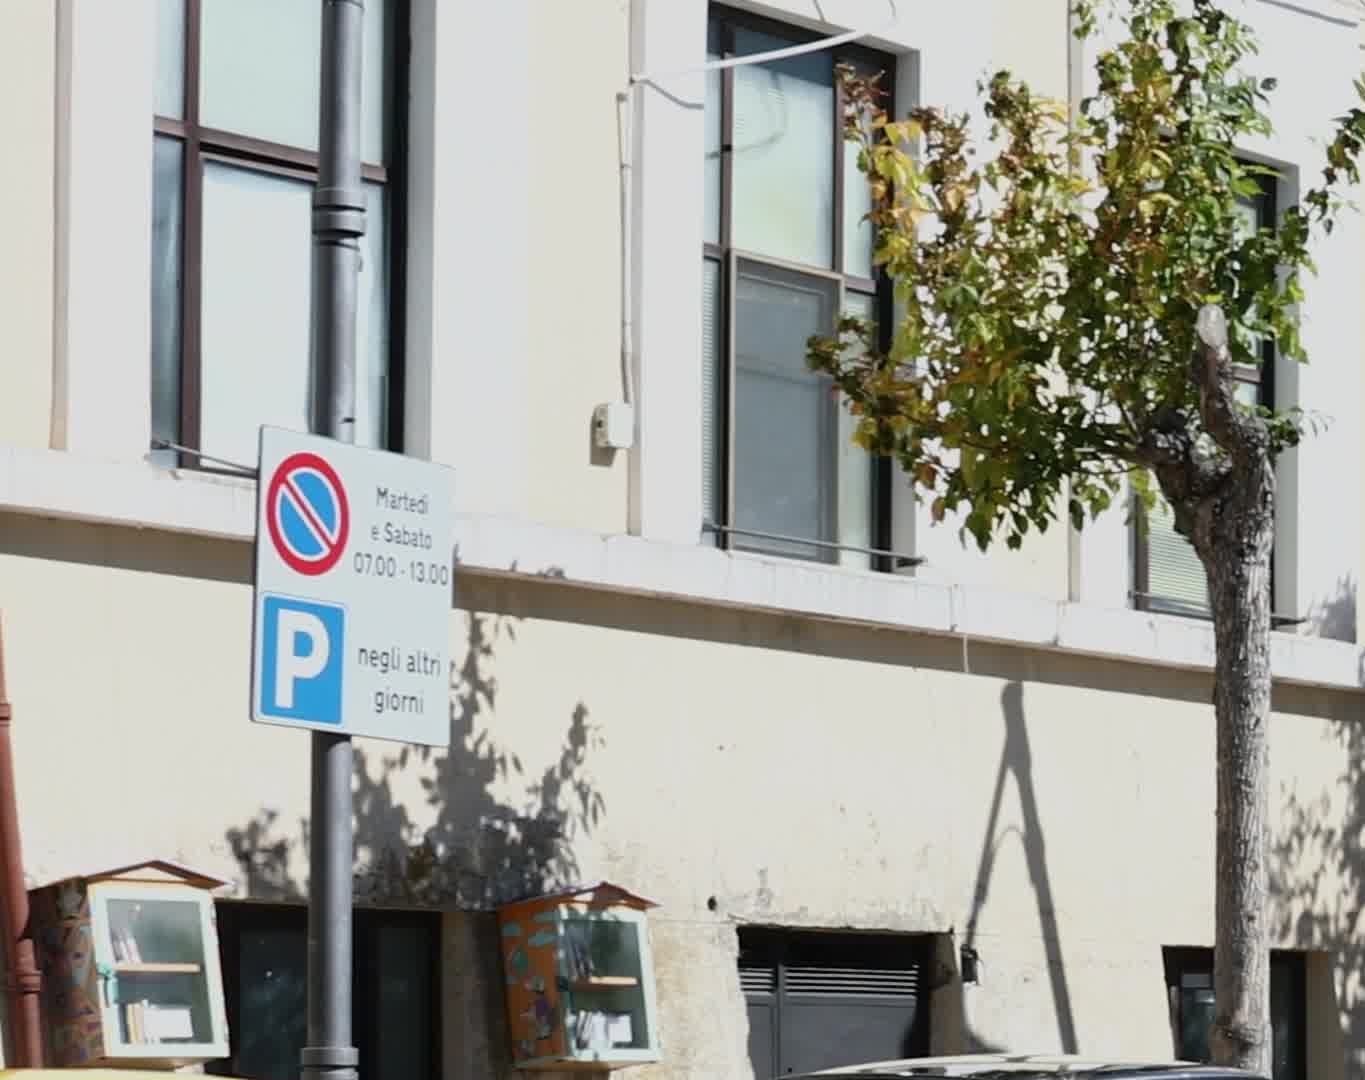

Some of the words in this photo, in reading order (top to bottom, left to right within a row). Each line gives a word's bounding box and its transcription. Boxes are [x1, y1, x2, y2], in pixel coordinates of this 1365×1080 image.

[371, 526, 380, 541] e
[384, 521, 433, 550] Sabato
[353, 551, 397, 577] 07.00
[410, 560, 449, 587] 13.00
[274, 608, 330, 709] P
[357, 644, 401, 674] negli
[407, 650, 441, 677] altri
[374, 684, 425, 714] giorni
